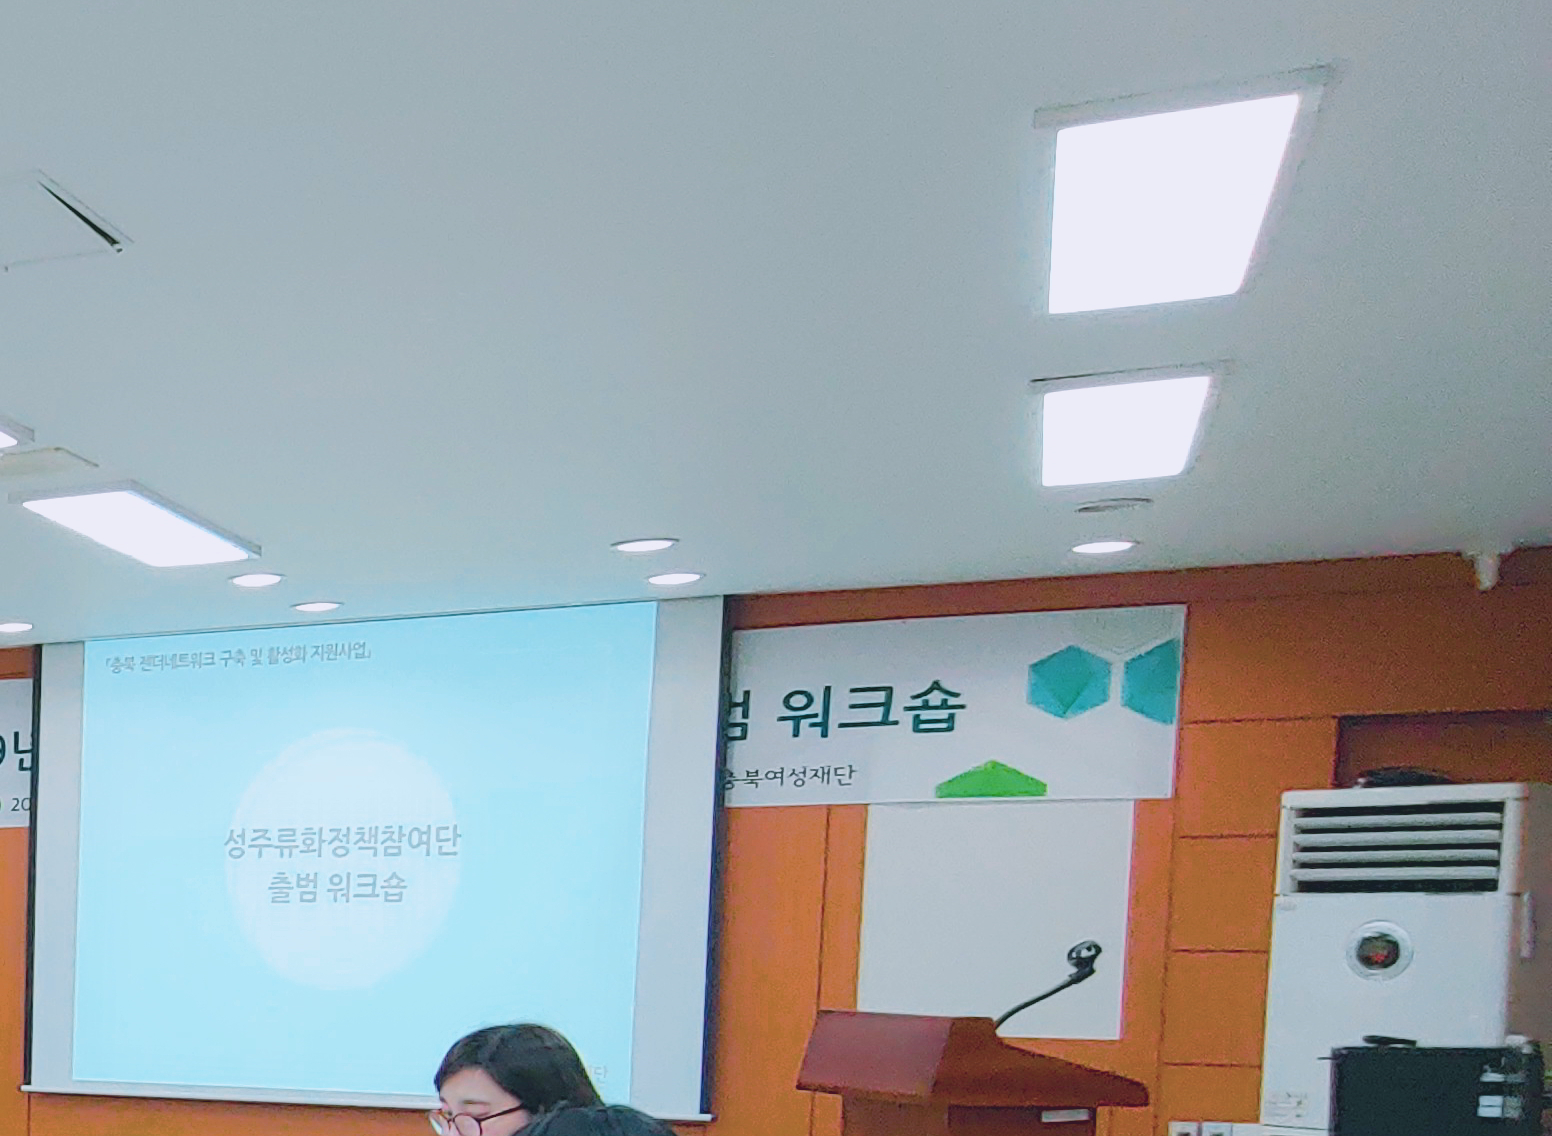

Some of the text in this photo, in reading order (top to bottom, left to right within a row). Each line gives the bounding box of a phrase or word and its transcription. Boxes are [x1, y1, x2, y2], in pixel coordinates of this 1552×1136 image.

[139, 651, 216, 672] 젠더네트워크
[220, 650, 246, 667] 구축
[250, 648, 263, 666] 및
[267, 645, 307, 665] 활성화
[777, 679, 966, 739] 워크숍
[224, 824, 462, 859] 성주류화정책참여단
[268, 872, 408, 903] 출범 워크숍
